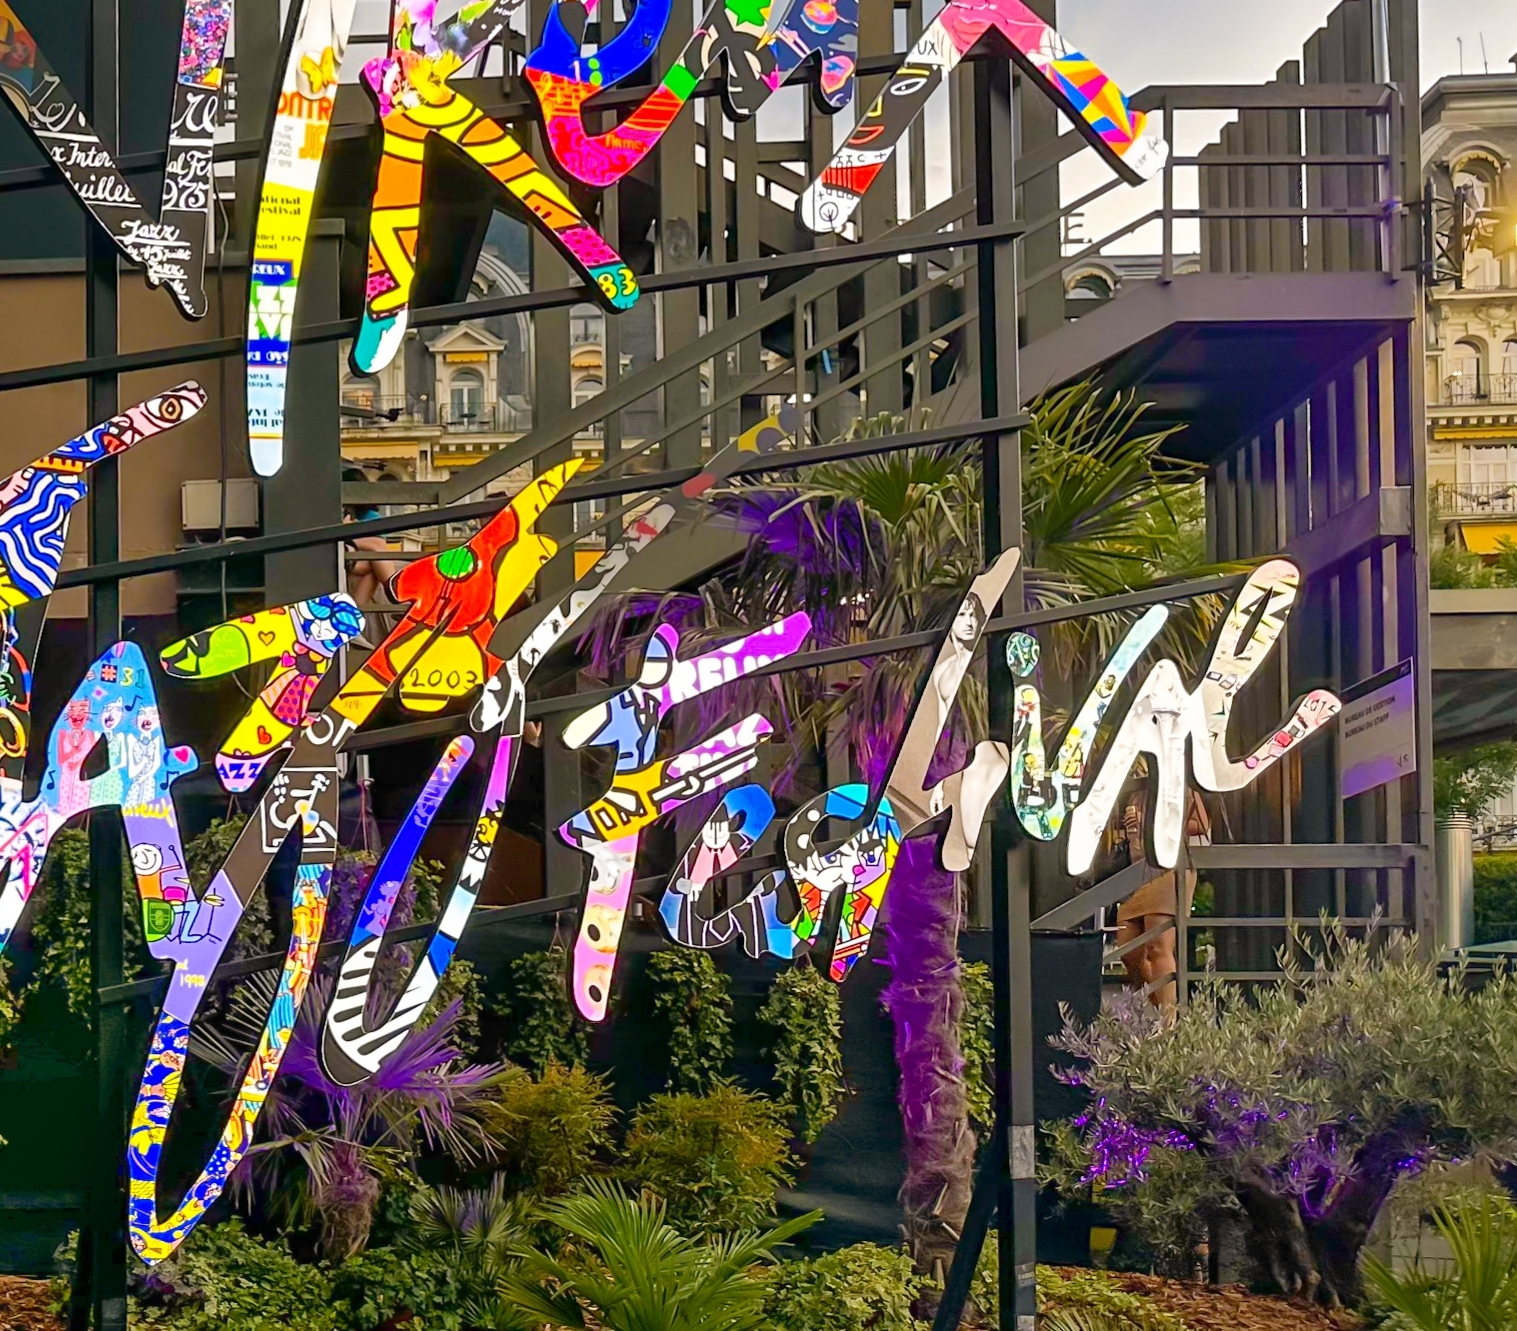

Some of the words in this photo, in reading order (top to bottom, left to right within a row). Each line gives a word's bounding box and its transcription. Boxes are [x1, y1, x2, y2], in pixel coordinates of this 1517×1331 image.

[597, 267, 636, 299] 83
[410, 668, 478, 690] 2003
[1373, 695, 1396, 711] GESTION
